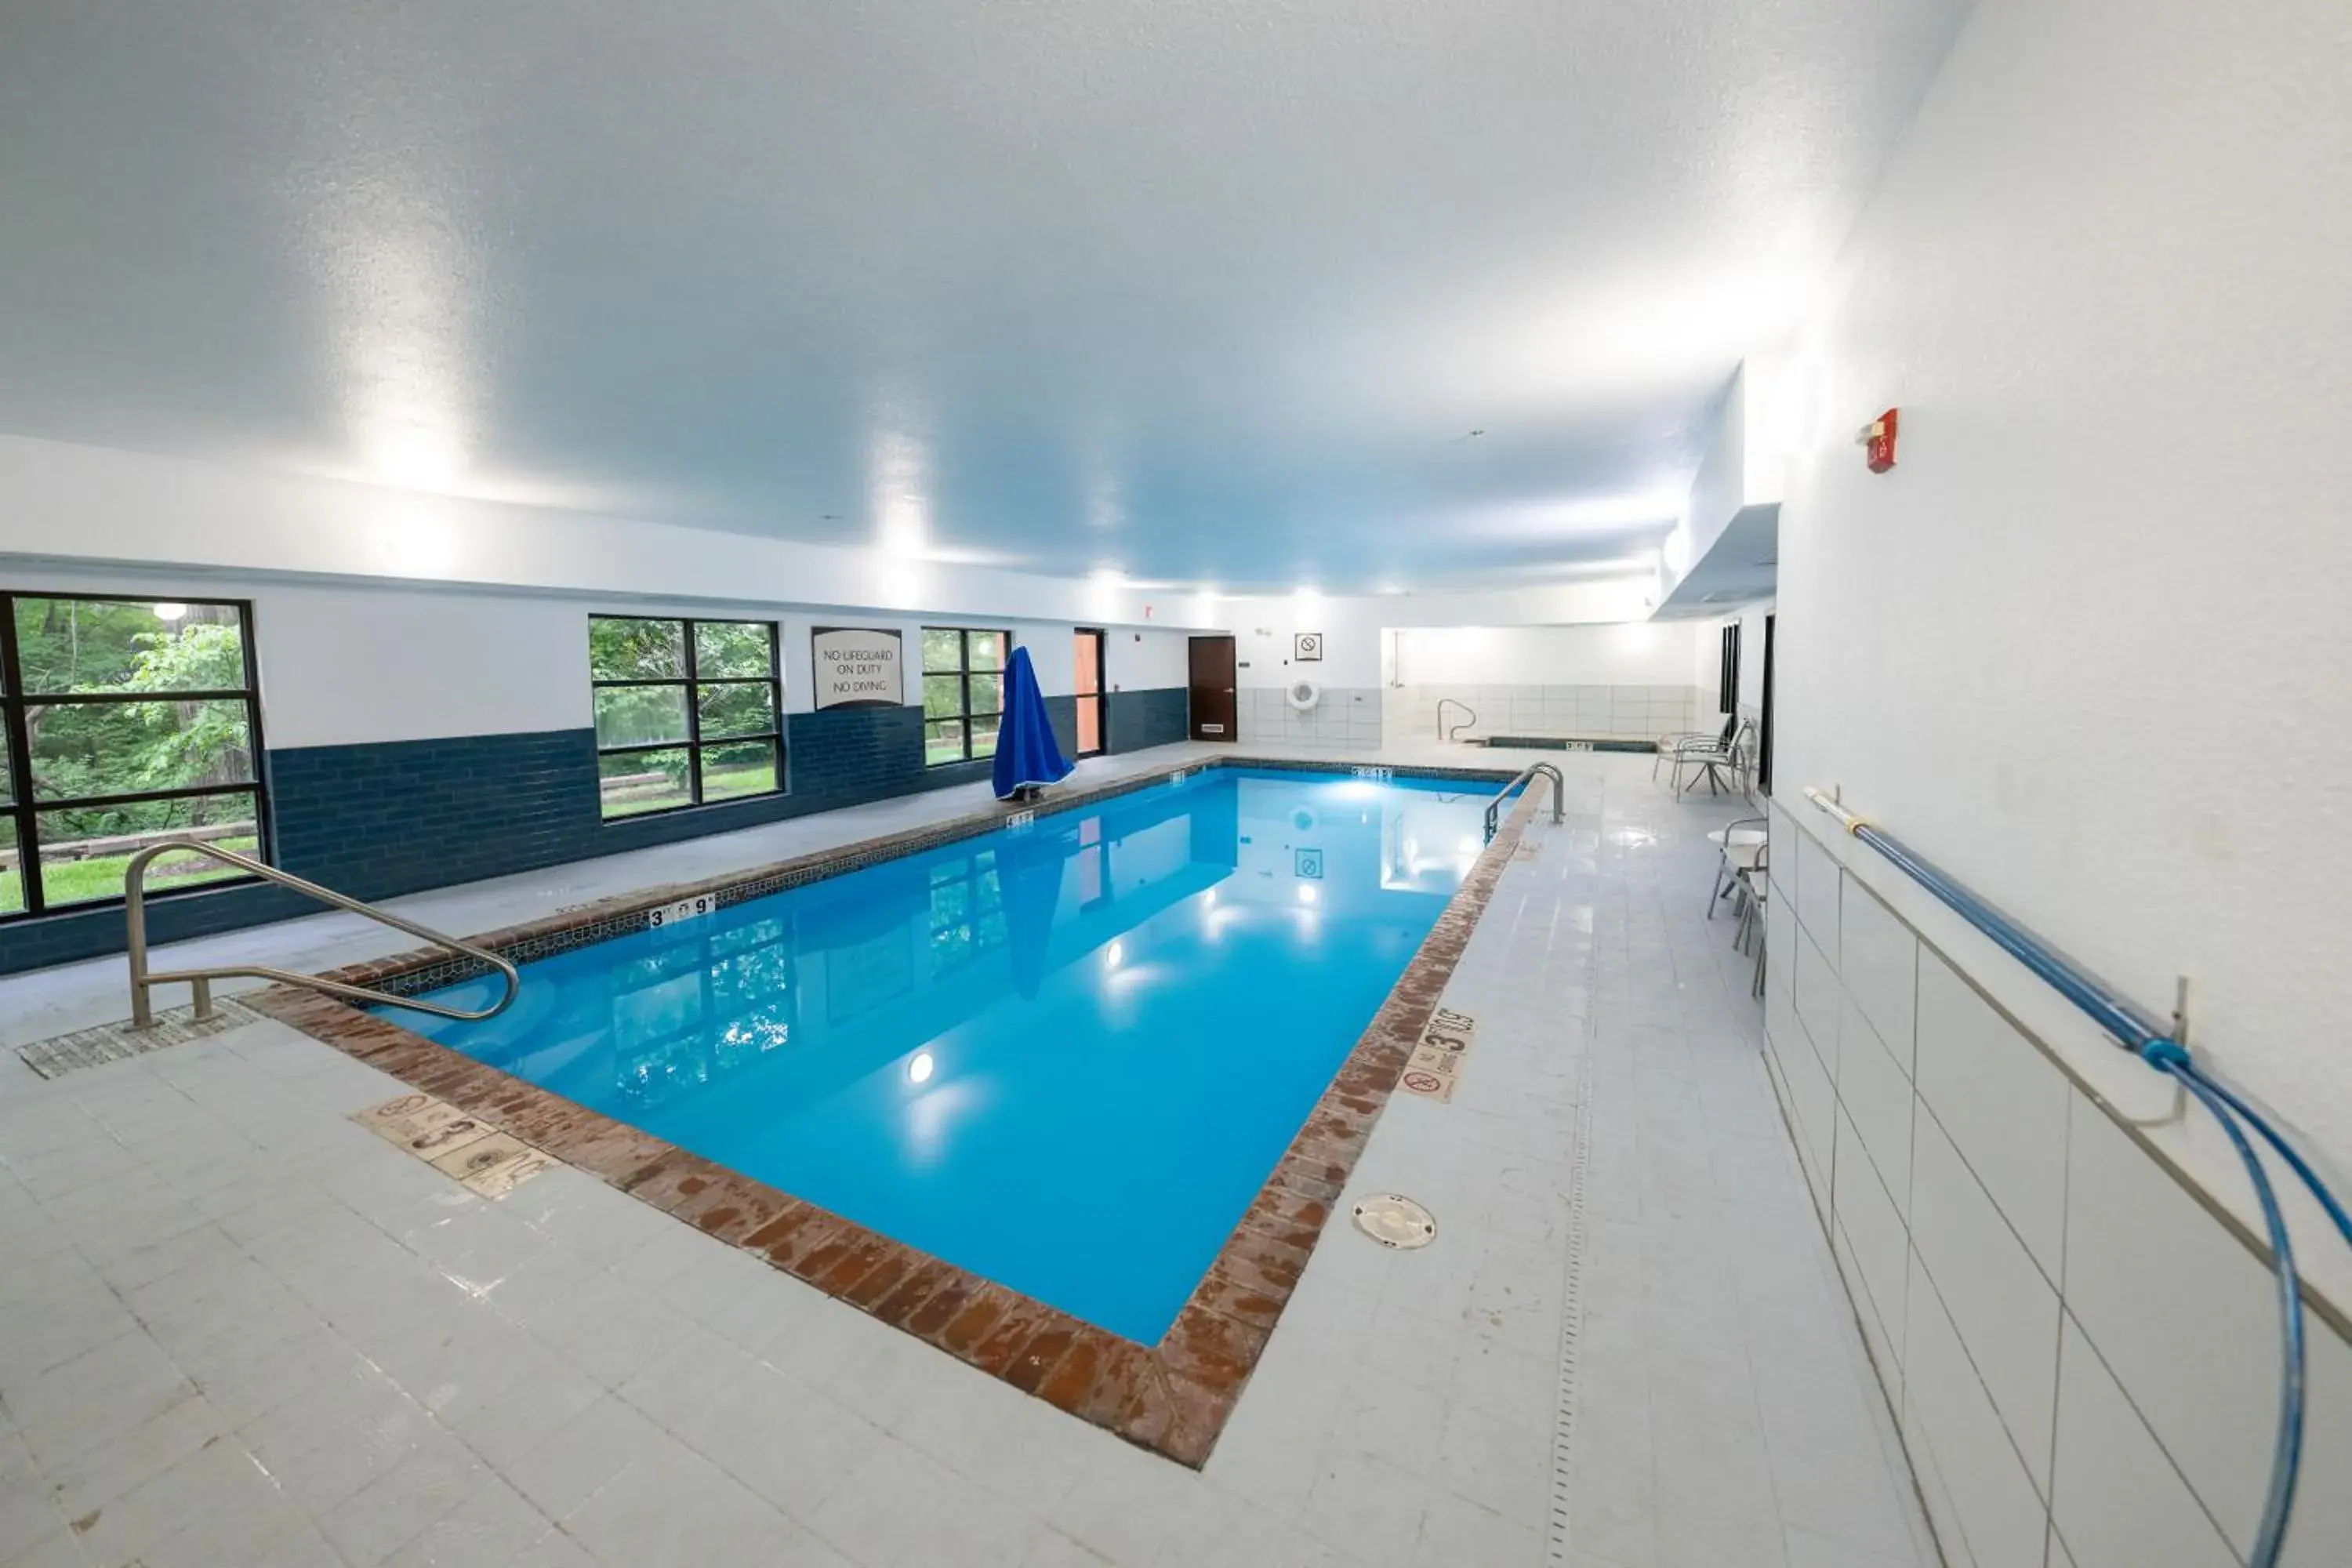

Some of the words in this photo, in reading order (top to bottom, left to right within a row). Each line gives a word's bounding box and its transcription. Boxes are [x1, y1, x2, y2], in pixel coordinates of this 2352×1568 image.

[823, 649, 840, 661] NO
[843, 649, 893, 661] LIFEGUARD
[837, 664, 854, 675] ON
[856, 663, 881, 675] DUTY
[833, 681, 851, 693] NO
[852, 680, 887, 691] DIVING
[652, 910, 662, 926] 3
